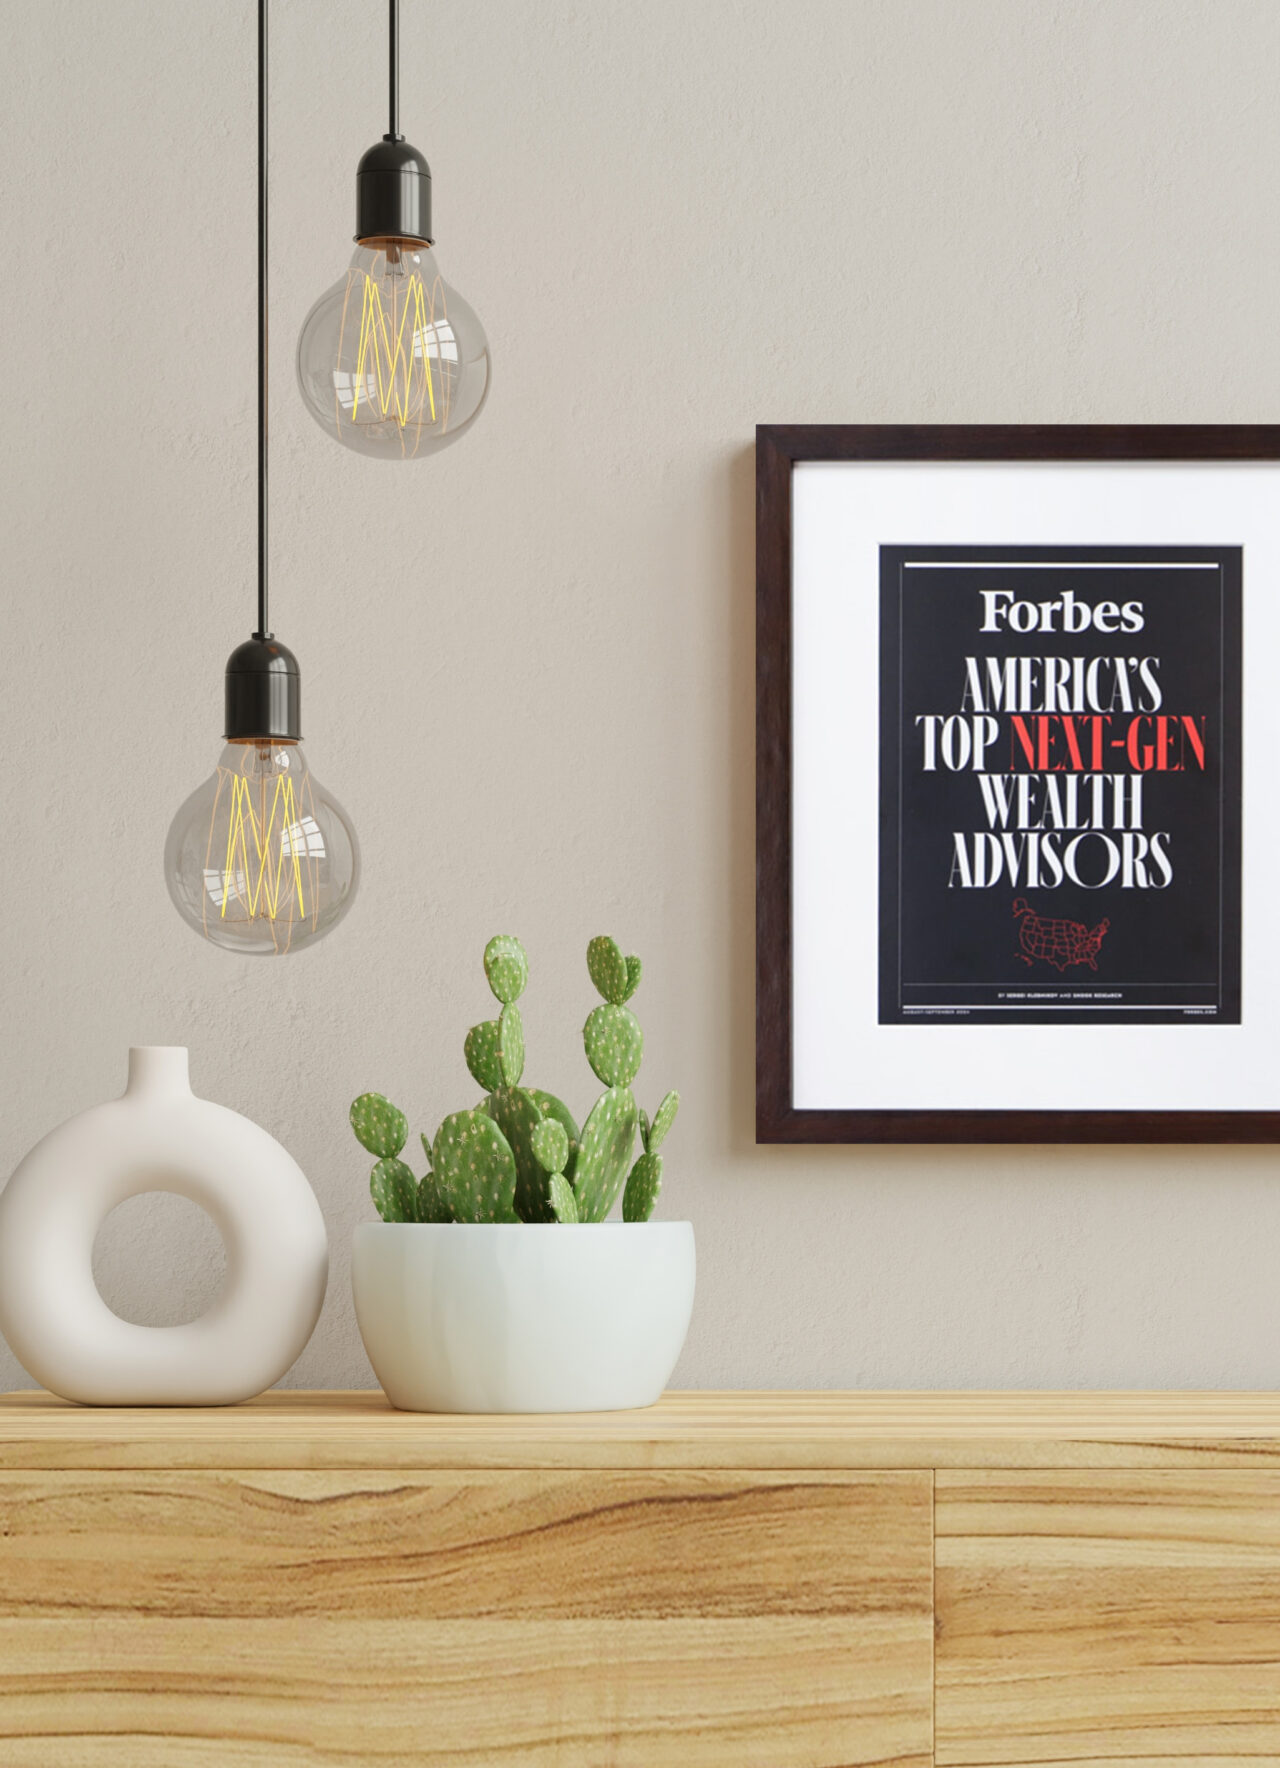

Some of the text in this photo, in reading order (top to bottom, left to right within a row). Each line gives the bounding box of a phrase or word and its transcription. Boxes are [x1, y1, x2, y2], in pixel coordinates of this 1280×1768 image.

[979, 590, 1145, 633] Forbes
[960, 657, 1163, 713] AMERICA'S
[915, 715, 1207, 772] TOP NEXT-GEN
[977, 774, 1144, 830] WEALTH
[948, 832, 1174, 889] ADVISORS
